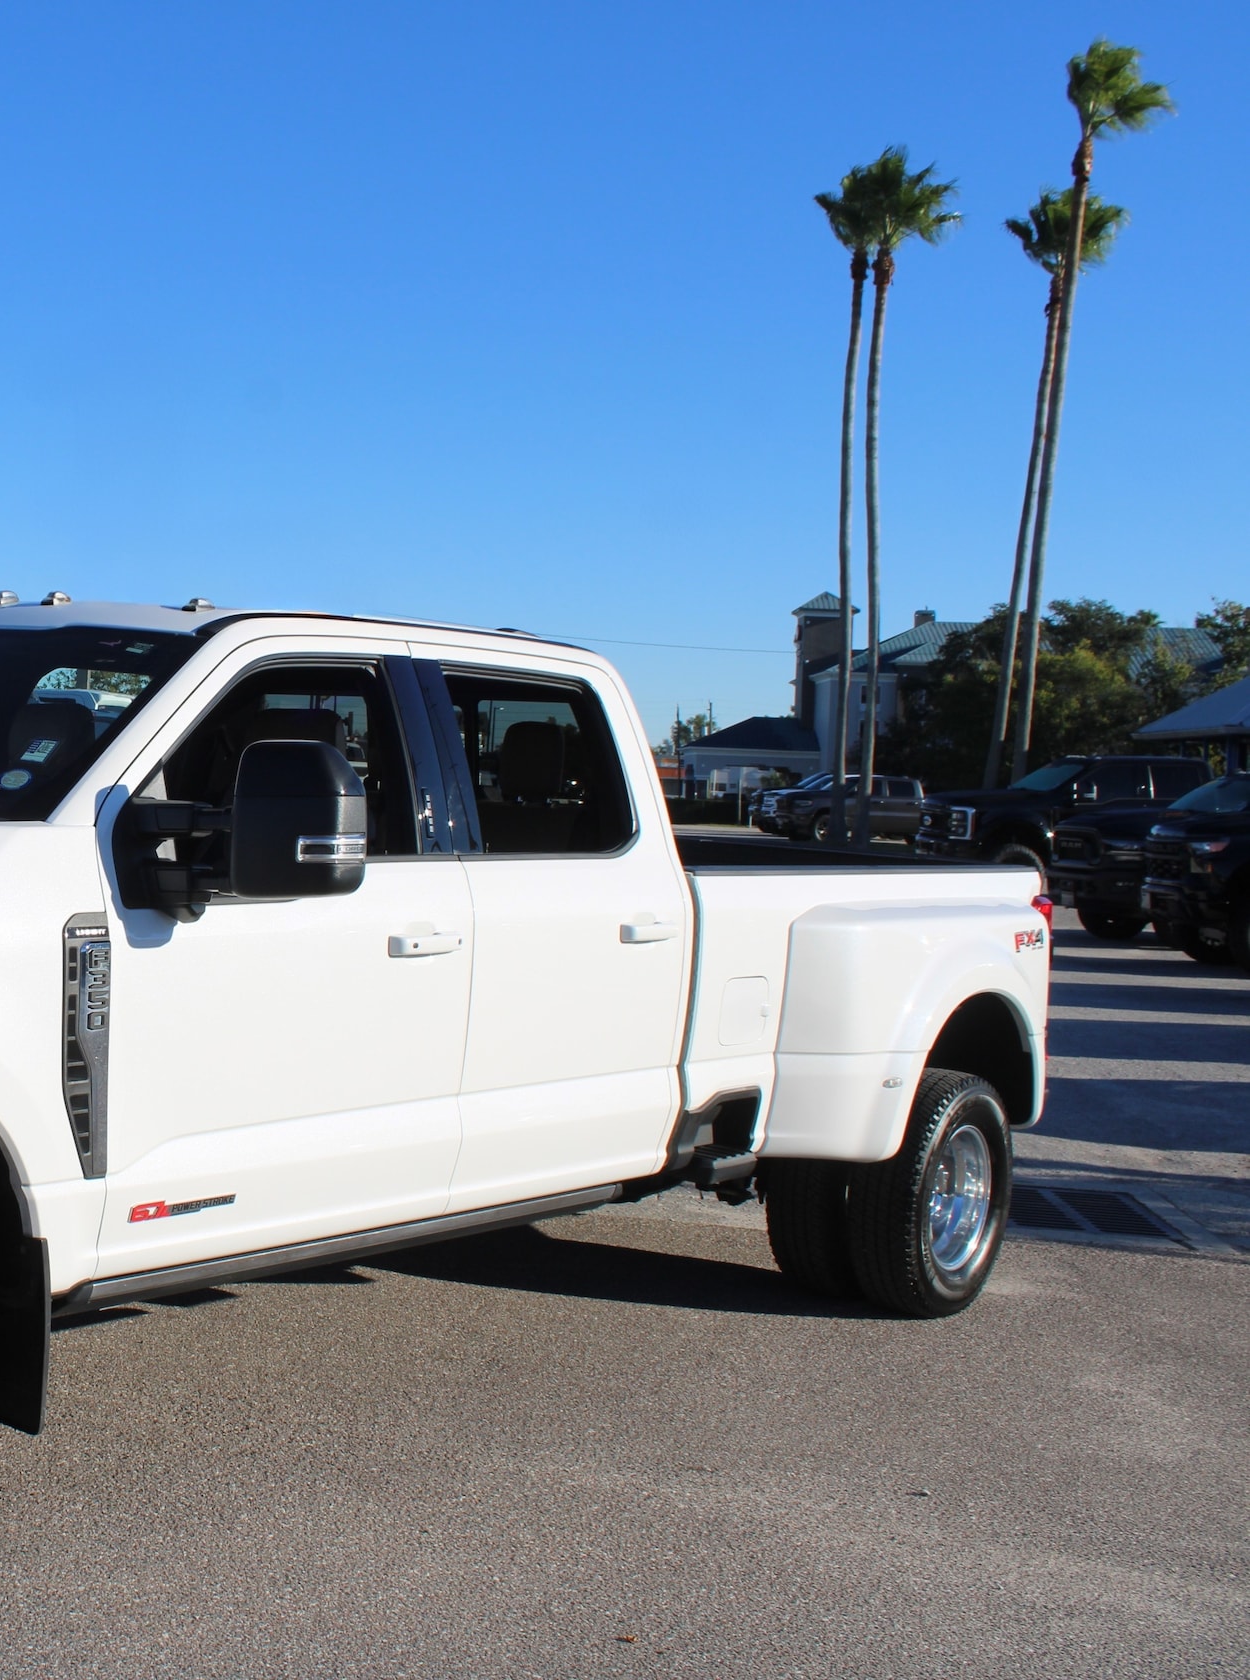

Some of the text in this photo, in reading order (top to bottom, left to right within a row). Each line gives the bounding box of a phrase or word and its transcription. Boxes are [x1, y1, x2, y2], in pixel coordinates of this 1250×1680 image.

[1014, 928, 1044, 952] FX4
[171, 1200, 201, 1213] POWER
[202, 1194, 236, 1208] STROKE
